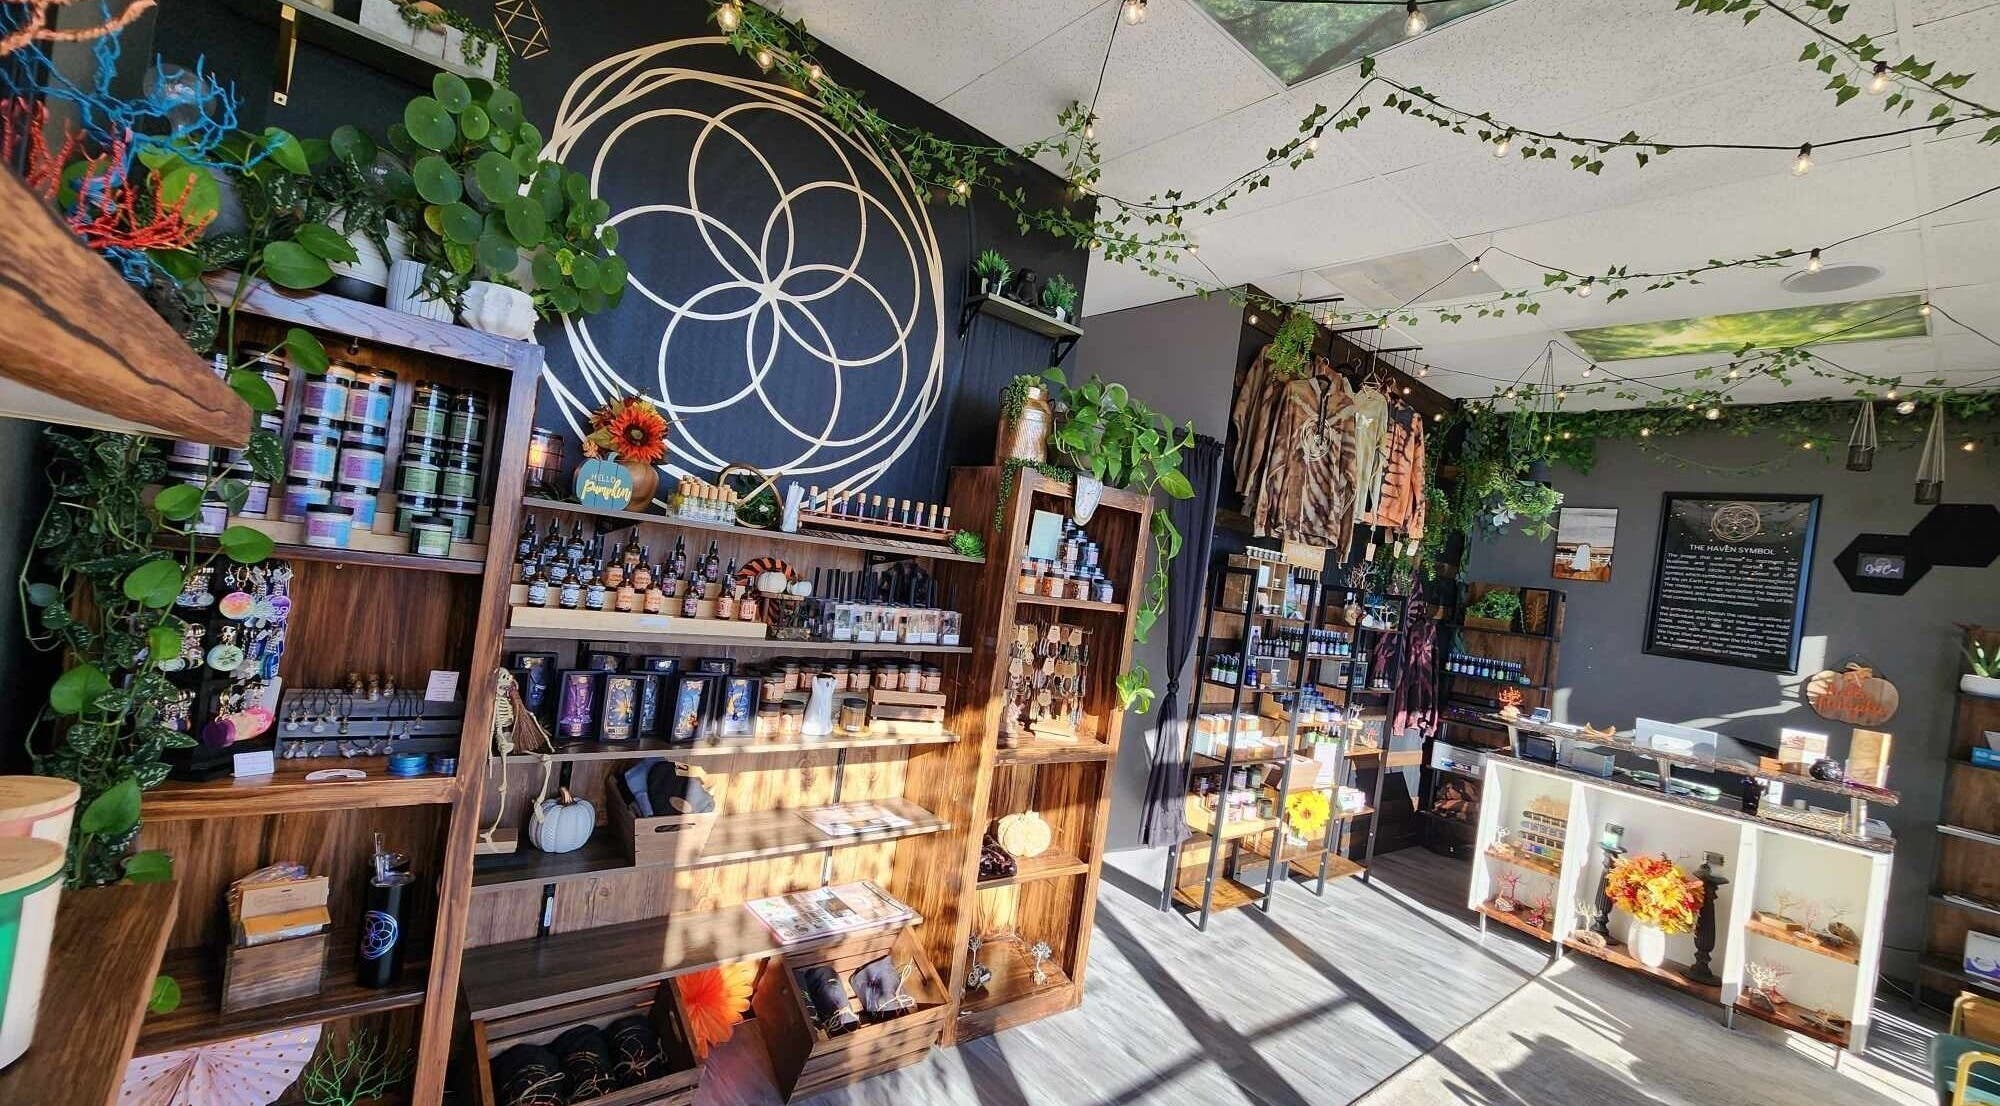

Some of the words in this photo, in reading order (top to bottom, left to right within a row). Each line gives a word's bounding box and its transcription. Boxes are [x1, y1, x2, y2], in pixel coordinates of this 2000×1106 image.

[591, 473, 616, 484] HELLO
[1706, 544, 1737, 553] HAVEN
[1738, 546, 1776, 555] SYMBOL
